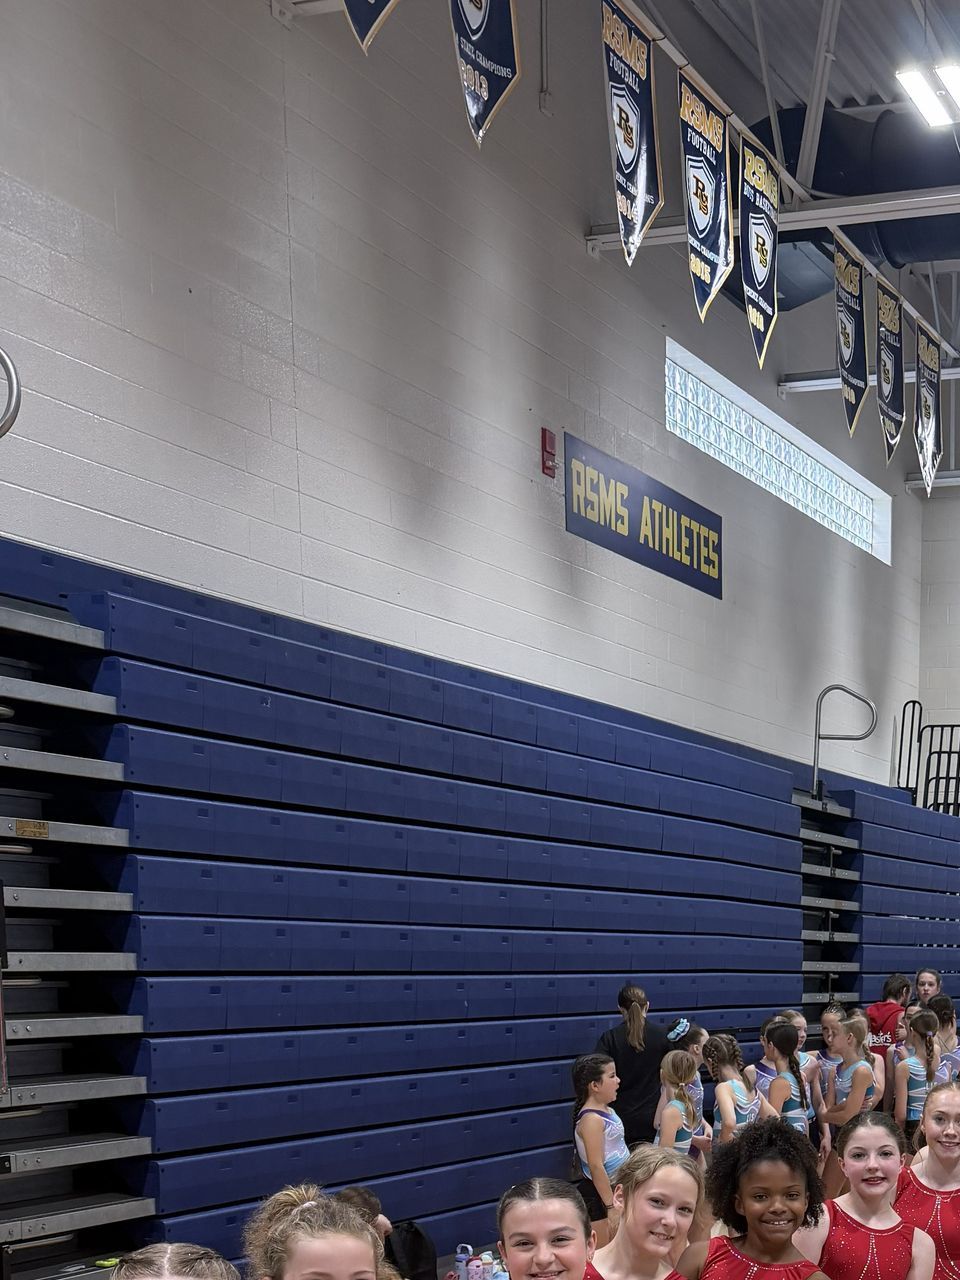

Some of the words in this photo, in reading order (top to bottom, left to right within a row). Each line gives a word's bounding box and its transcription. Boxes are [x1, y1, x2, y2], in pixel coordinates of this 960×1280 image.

[603, 1, 647, 80] RSMS
[609, 52, 640, 94] FOOTBALL
[680, 82, 724, 153] RSMS
[687, 127, 717, 166] FOOTBALL
[571, 458, 629, 537] RSMS
[639, 496, 719, 579] ATHLETES
